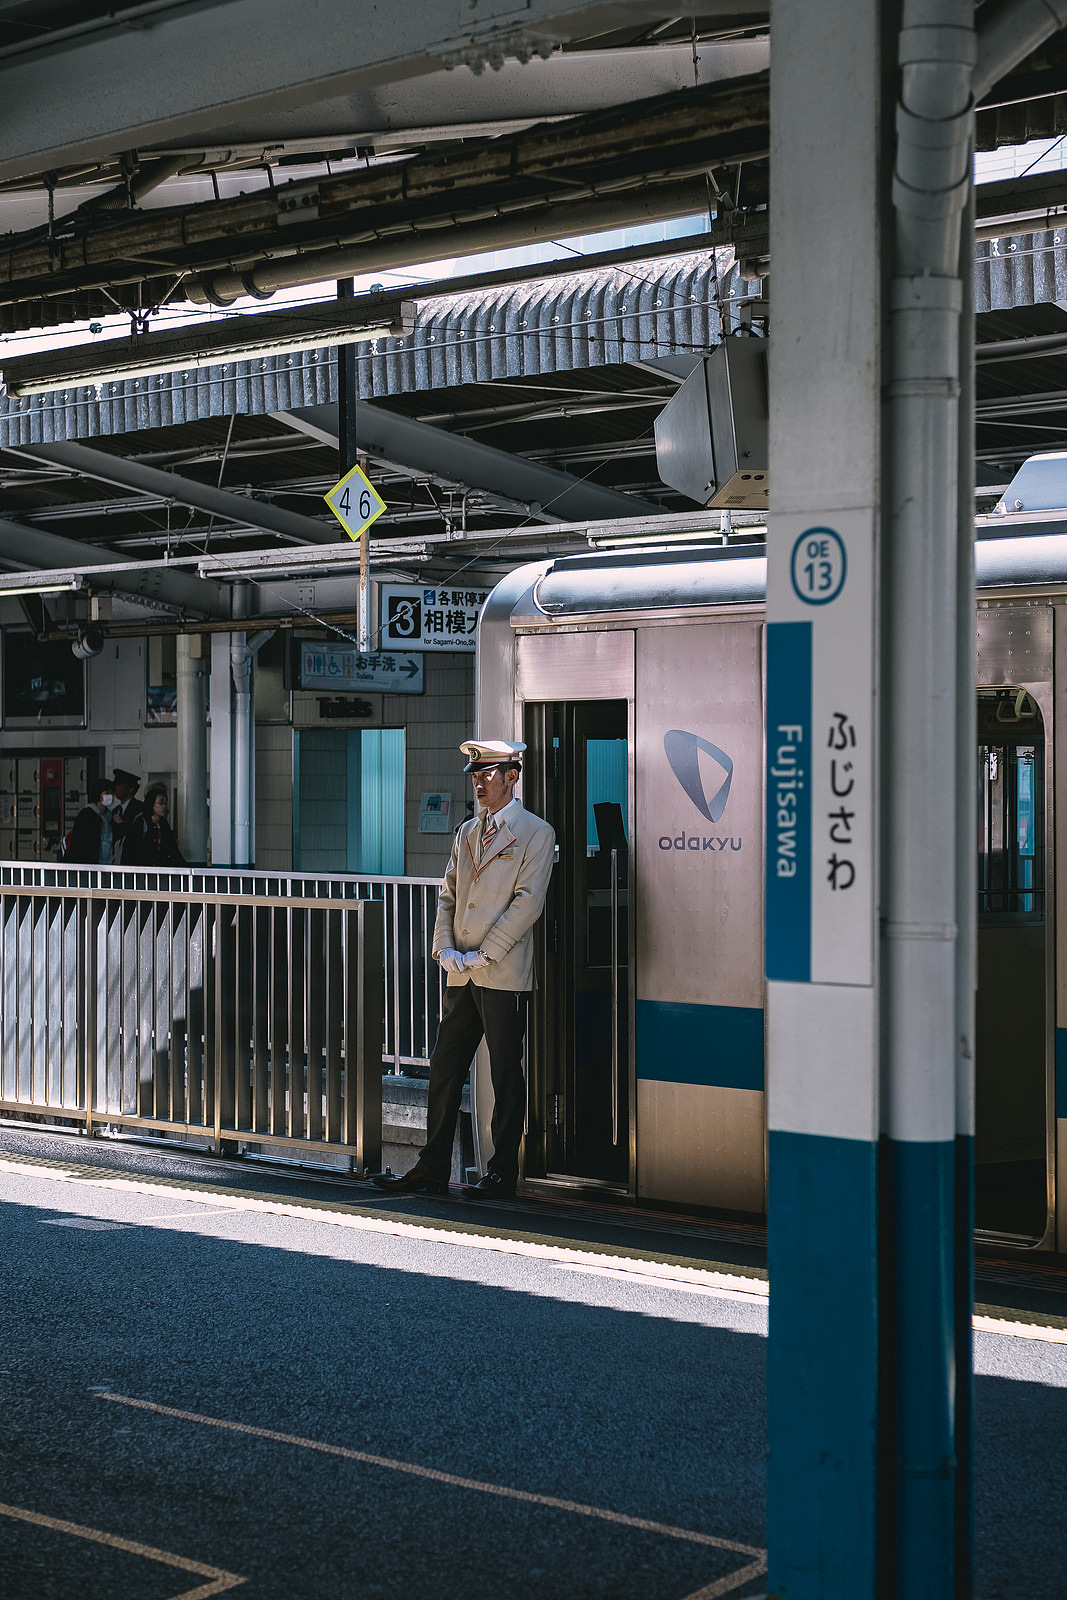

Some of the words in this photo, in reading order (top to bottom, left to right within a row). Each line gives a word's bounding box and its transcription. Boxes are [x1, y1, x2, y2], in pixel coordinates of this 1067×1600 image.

[806, 540, 829, 559] OE
[803, 562, 832, 591] 13
[395, 600, 415, 636] 3
[355, 655, 396, 672] お手洗
[356, 672, 374, 680] Toilets
[771, 724, 803, 878] Fujisawa
[827, 712, 856, 891] ふじさわ
